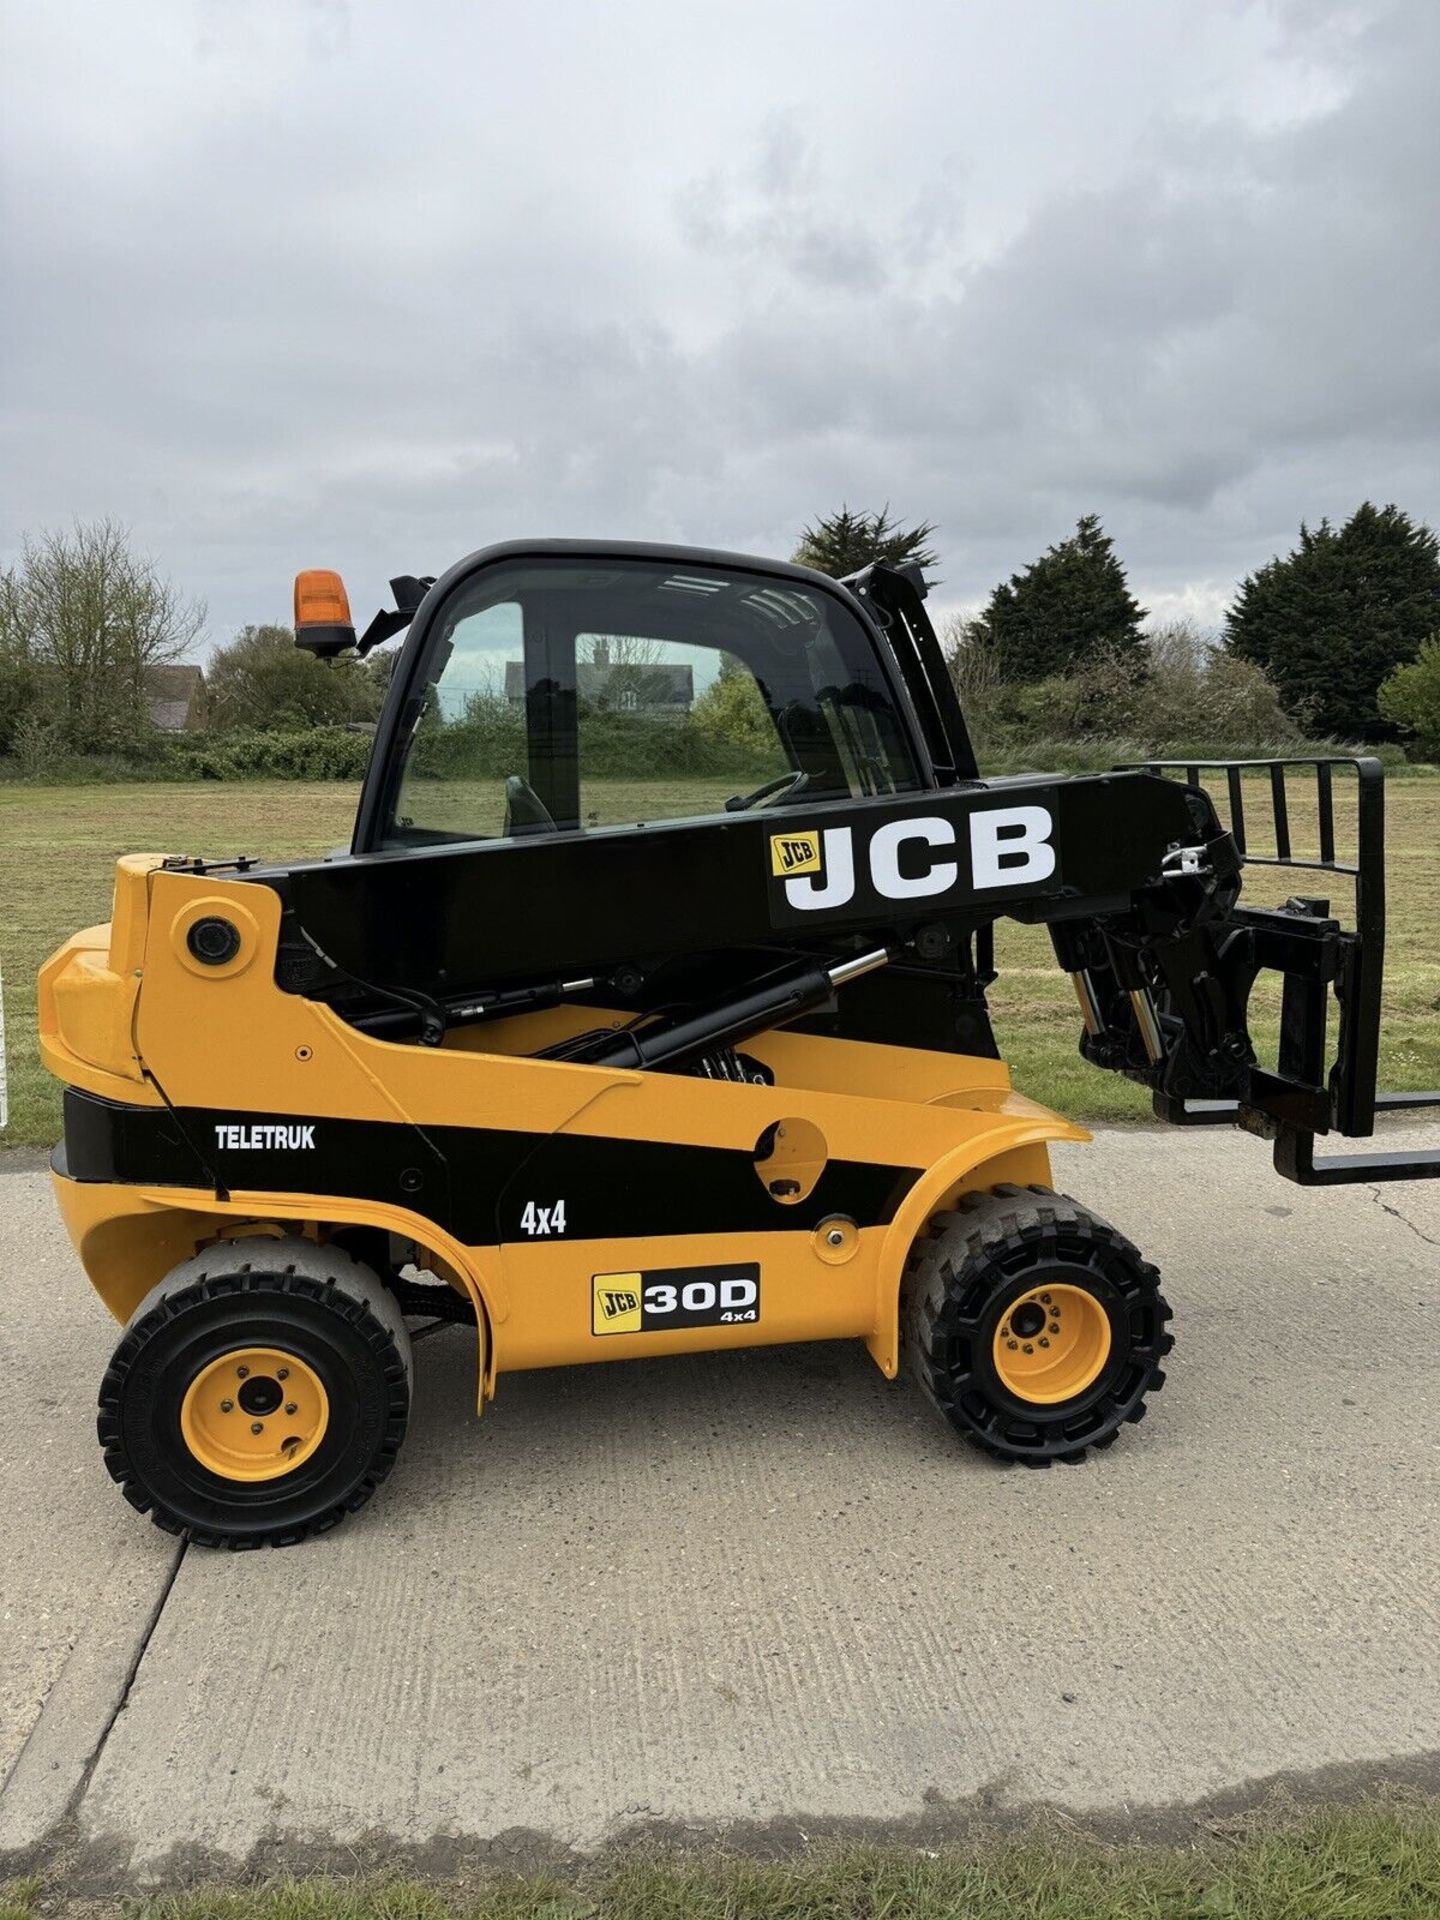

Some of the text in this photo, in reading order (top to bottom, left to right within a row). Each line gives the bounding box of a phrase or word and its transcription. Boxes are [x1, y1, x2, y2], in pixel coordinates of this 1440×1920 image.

[781, 841, 814, 867] JCB
[785, 806, 1056, 910] JCB
[215, 1125, 316, 1150] TELETRUK
[520, 1199, 567, 1235] 4x4
[604, 1292, 637, 1316] JCB
[644, 1279, 757, 1314] 30D
[720, 1309, 756, 1322] 4x4
